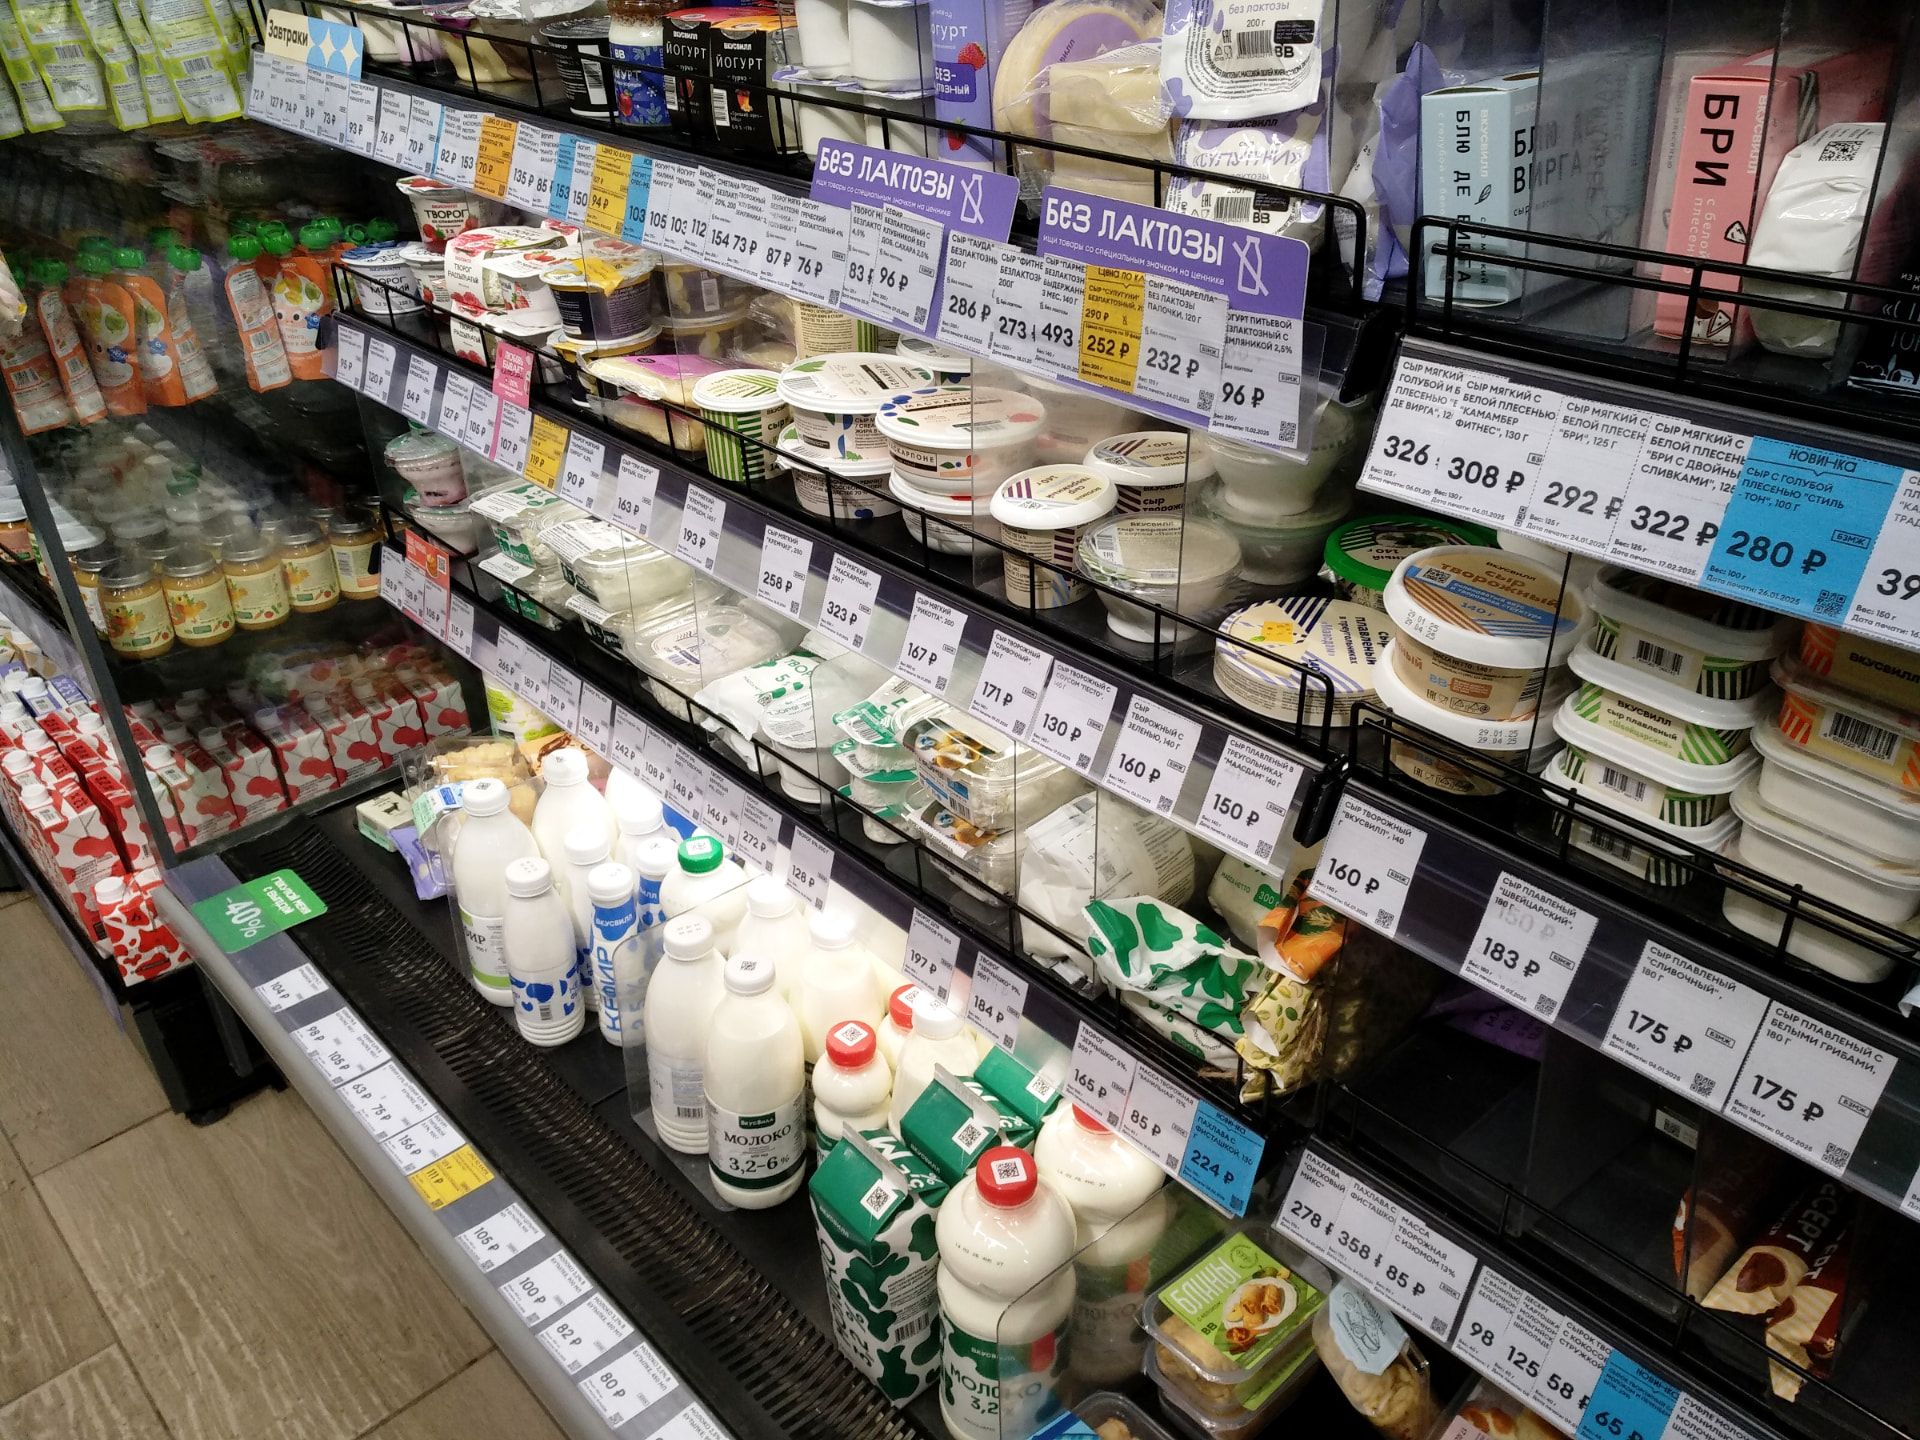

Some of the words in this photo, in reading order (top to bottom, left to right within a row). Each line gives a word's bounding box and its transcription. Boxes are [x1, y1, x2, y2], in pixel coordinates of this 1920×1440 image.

[1229, 4, 1244, 14] без
[1246, 2, 1289, 12] лактозы
[268, 20, 308, 46] Завтраки
[666, 41, 706, 60] ЙОГУРТ
[716, 56, 762, 70] ЙОГУРТ
[1455, 109, 1472, 155] БЛЮ
[1693, 93, 1741, 189] БРИ
[409, 139, 417, 151] 70
[441, 149, 450, 161] 82
[461, 155, 473, 169] 153
[513, 169, 527, 184] 135
[537, 179, 547, 192] 85
[858, 156, 954, 200] ЛАКТОЗЫ
[592, 194, 602, 207] 94
[424, 209, 470, 220] ТВОРОГ
[629, 206, 645, 221] 103
[650, 212, 666, 228] 105
[692, 219, 705, 237] 112
[711, 229, 729, 247] 154
[952, 234, 966, 244] СЫР
[1098, 210, 1224, 266] ЛАКТОЗЫ
[734, 235, 746, 250] 73
[766, 249, 780, 264] 87
[798, 256, 810, 274] 76
[1043, 234, 1058, 245] ищи
[1059, 237, 1084, 252] товары
[1086, 243, 1094, 252] со
[1096, 247, 1145, 266] специальным
[1146, 258, 1177, 272] значком
[1180, 266, 1189, 276] на
[1191, 269, 1224, 285] ценнике
[849, 265, 864, 281] 83
[880, 266, 895, 287] 96
[1149, 280, 1163, 290] СЫР
[950, 295, 977, 319] 286
[1148, 291, 1162, 301] БЕЗ
[1164, 294, 1195, 310] ЛАКТОЗЫ
[1086, 308, 1102, 320] 290
[1184, 312, 1195, 322] 120
[999, 316, 1027, 340] 273
[1041, 322, 1073, 348] 493
[1087, 334, 1116, 356] 252
[1146, 348, 1180, 375] 232
[1222, 382, 1246, 406] 96
[1466, 381, 1487, 393] СЫР
[1489, 384, 1532, 402] МЯГКИЙ
[1460, 406, 1519, 426] "КАМАМБЕР
[1462, 392, 1498, 409] БЕЛОЙ
[1499, 398, 1556, 420] ПЛЕСЕНЬЮ
[1567, 402, 1589, 415] СЫР
[1591, 406, 1637, 426] МЯГКИЙ
[1504, 430, 1521, 442] 130
[1592, 436, 1609, 448] 125
[1654, 422, 1681, 436] СЫР
[1682, 428, 1732, 447] МЯГКИЙ
[1384, 435, 1430, 466] 326
[567, 472, 577, 485] 90
[1448, 456, 1499, 489] 308
[1746, 467, 1770, 482] СЫР
[1781, 475, 1833, 494] ГОЛУБОЙ
[617, 497, 632, 512] 163
[1543, 481, 1598, 516] 292
[1742, 478, 1801, 499] ПЛЕСЕНЬЮ
[1804, 492, 1844, 510] "СТИЛЬ
[1775, 500, 1792, 511] 100
[1630, 504, 1690, 542] 322
[683, 528, 698, 546] 193
[1726, 530, 1794, 568] 280
[762, 571, 782, 590] 258
[1484, 567, 1527, 590] сыр
[1706, 574, 1732, 586] Дата
[1710, 565, 1726, 575] Вес:
[1728, 569, 1740, 578] 100
[1440, 562, 1561, 608] творожный
[827, 602, 847, 623] 323
[1460, 601, 1484, 617] 140
[907, 642, 927, 662] 167
[982, 681, 1002, 701] 171
[1042, 713, 1068, 737] 130
[1606, 706, 1626, 721] сыр
[1628, 712, 1678, 742] плавленый
[1617, 699, 1673, 728] ВКУСВИЛЛ
[1163, 737, 1174, 748] 140
[1119, 753, 1146, 778] 160
[1266, 775, 1276, 786] 140
[1212, 793, 1243, 821] 150
[1344, 801, 1361, 816] СЫР
[1362, 808, 1412, 838] ТВОРОЖНЫЙ
[1327, 858, 1361, 887] 160
[1502, 877, 1520, 892] СЫР
[1522, 885, 1577, 918] ПЛАВЛЕНЫЙ
[225, 896, 266, 938] -40%
[909, 949, 928, 969] 197
[1482, 937, 1519, 970] 183
[1641, 966, 1657, 980] 180
[1650, 946, 1671, 962] СЫР
[1672, 955, 1737, 993] ПЛАВЛЕНЫЙ
[974, 994, 993, 1017] 184
[1627, 1010, 1670, 1046] 175
[1765, 1028, 1782, 1043] 180
[1775, 1007, 1799, 1025] СЫР
[1800, 1018, 1872, 1057] ПЛАВЛЕНЫЙ
[1770, 1018, 1818, 1047] БЕЛЫМИ
[1819, 1042, 1877, 1075] ГРИБАМИ,
[1072, 1068, 1096, 1092] 165
[1750, 1073, 1798, 1112] 175
[1130, 1109, 1148, 1130] 85
[723, 1123, 792, 1147] МОЛОКО
[1190, 1150, 1220, 1178] 224
[1306, 1153, 1341, 1180] ПАХЛАВА
[1290, 1200, 1322, 1229] 278
[473, 1226, 492, 1246] 105
[1401, 1215, 1430, 1239] МАССА
[1338, 1230, 1371, 1261] 358
[519, 1276, 539, 1298] 100
[1169, 1255, 1243, 1316] БЛИНЫ
[1385, 1264, 1409, 1289] 85
[556, 1323, 575, 1340] 82
[1469, 1322, 1494, 1347] 98
[1506, 1345, 1539, 1378] 125
[600, 1372, 618, 1390] 80
[1546, 1373, 1575, 1400] 58
